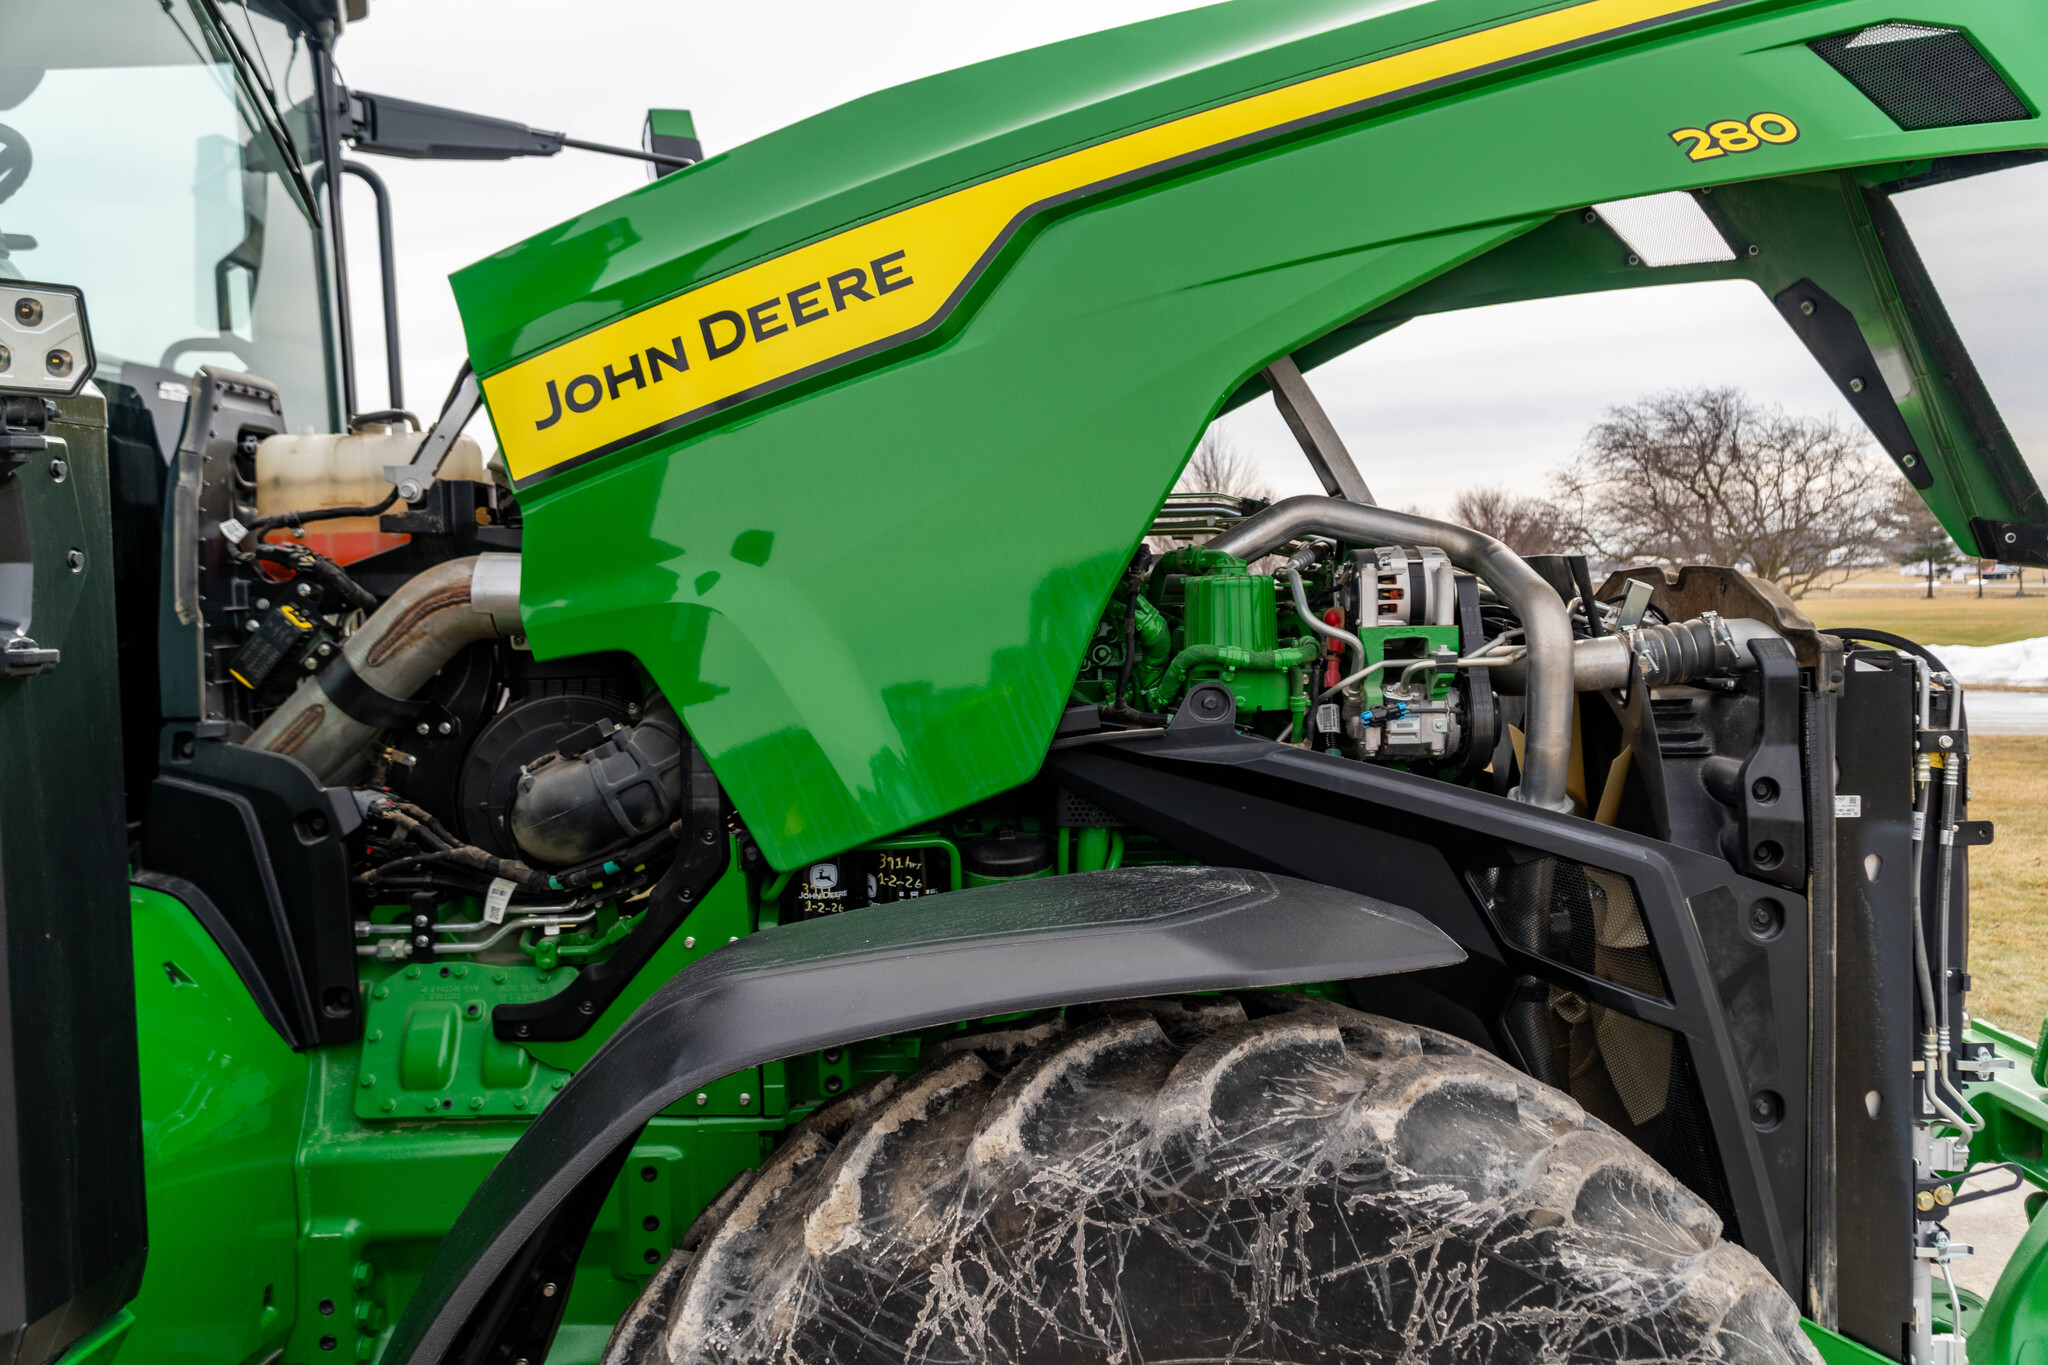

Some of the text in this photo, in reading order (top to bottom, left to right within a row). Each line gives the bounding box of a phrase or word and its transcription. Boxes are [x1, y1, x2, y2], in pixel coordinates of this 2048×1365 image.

[1668, 111, 1800, 163] 280
[535, 249, 914, 431] JOHN DEERE
[877, 872, 923, 889] 1-2-26
[798, 890, 848, 900] JOHN DEERE
[804, 900, 844, 913] 1-2-26
